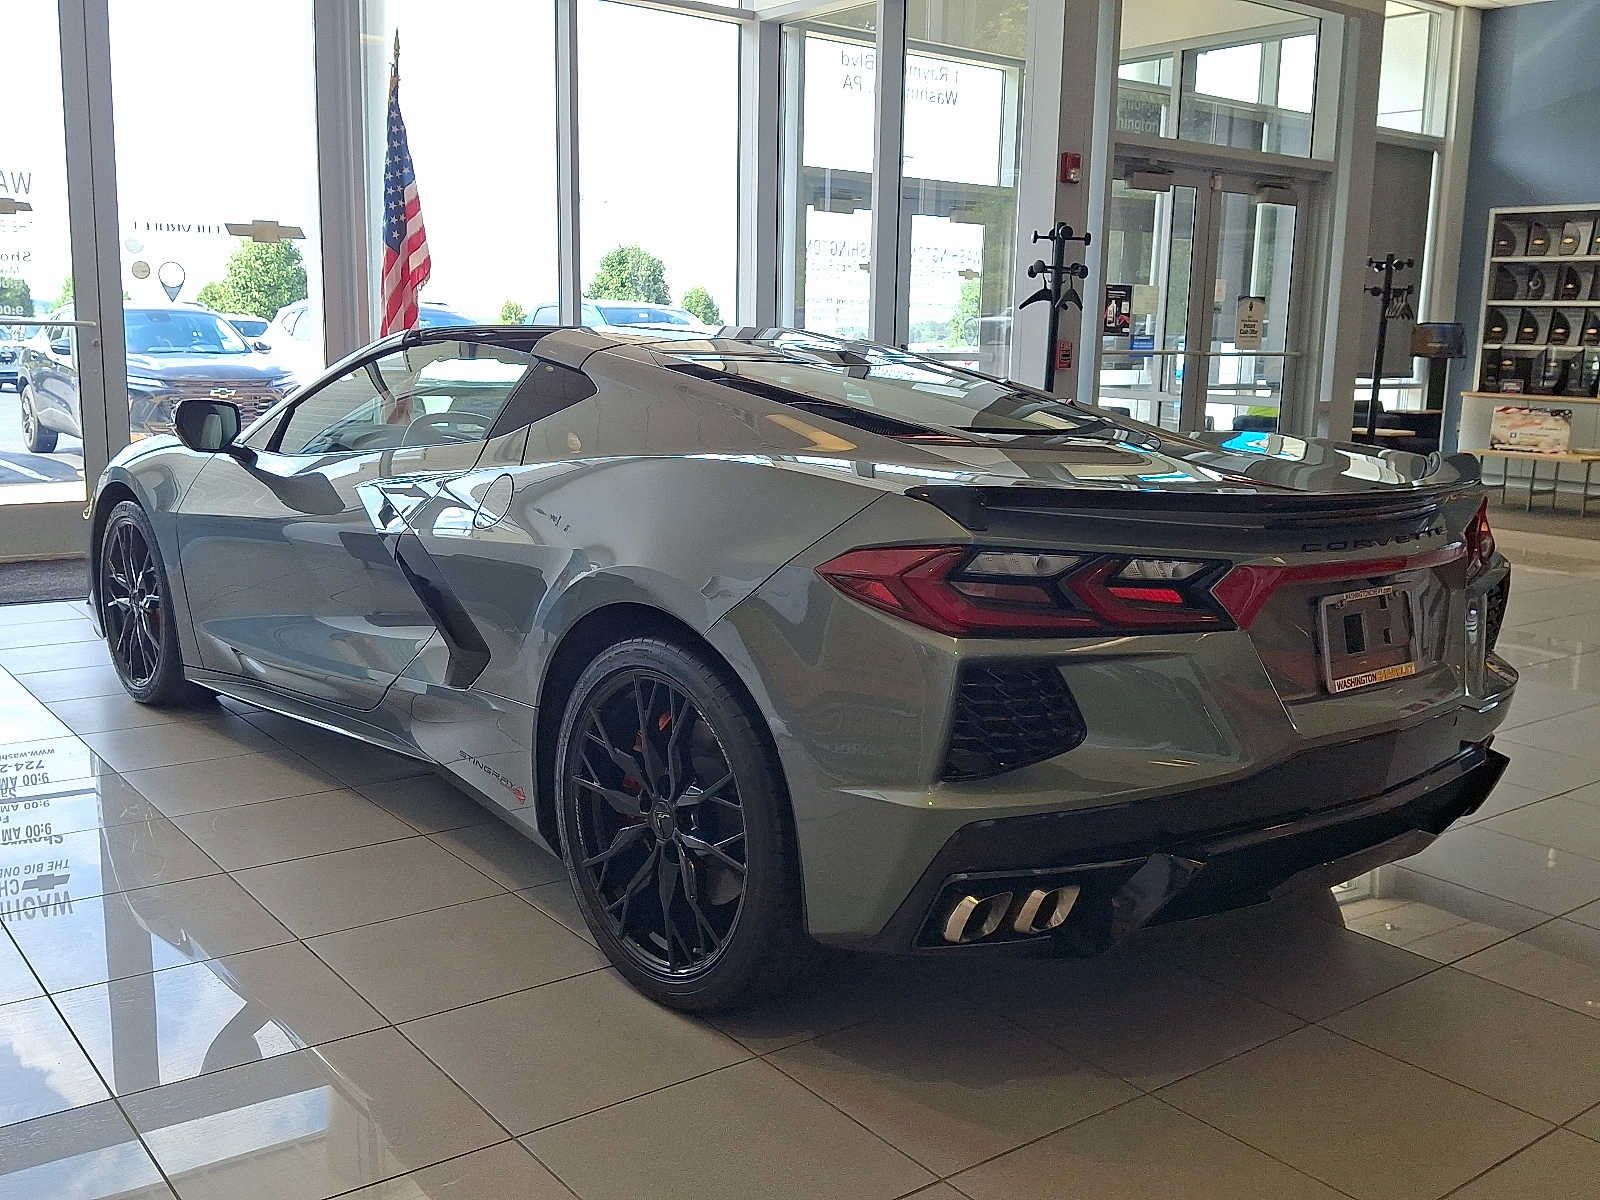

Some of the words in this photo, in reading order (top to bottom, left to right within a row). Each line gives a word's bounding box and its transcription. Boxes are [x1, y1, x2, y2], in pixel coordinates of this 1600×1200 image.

[1336, 672, 1377, 691] WASHINGTON
[457, 750, 516, 789] STINGRAY
[23, 772, 49, 786] 9:00
[0, 804, 18, 813] AM
[24, 800, 50, 810] 9:00
[1, 828, 20, 842] AM
[26, 823, 52, 838] 9:00
[24, 863, 44, 875] BIG
[47, 859, 69, 872] THE
